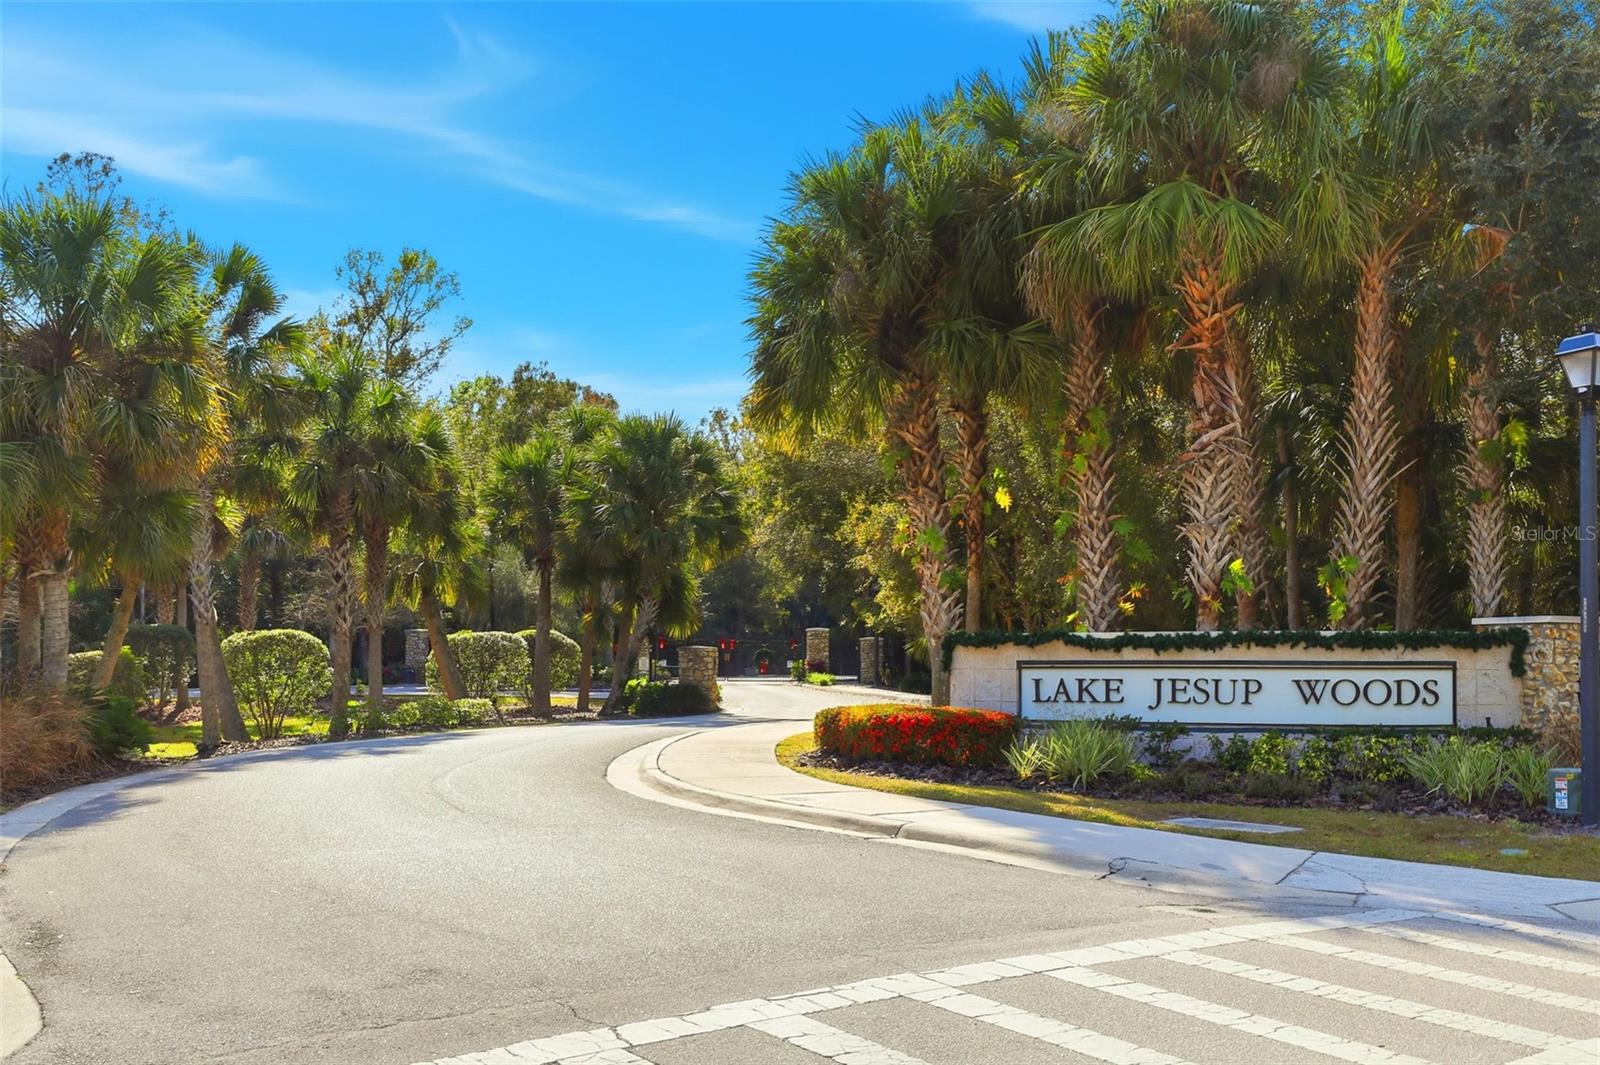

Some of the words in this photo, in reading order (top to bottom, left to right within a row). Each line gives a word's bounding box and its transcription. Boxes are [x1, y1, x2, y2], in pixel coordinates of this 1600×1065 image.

[1031, 677, 1125, 704] LAKE
[1147, 678, 1263, 710] JESUP
[1291, 678, 1440, 706] WOODS
